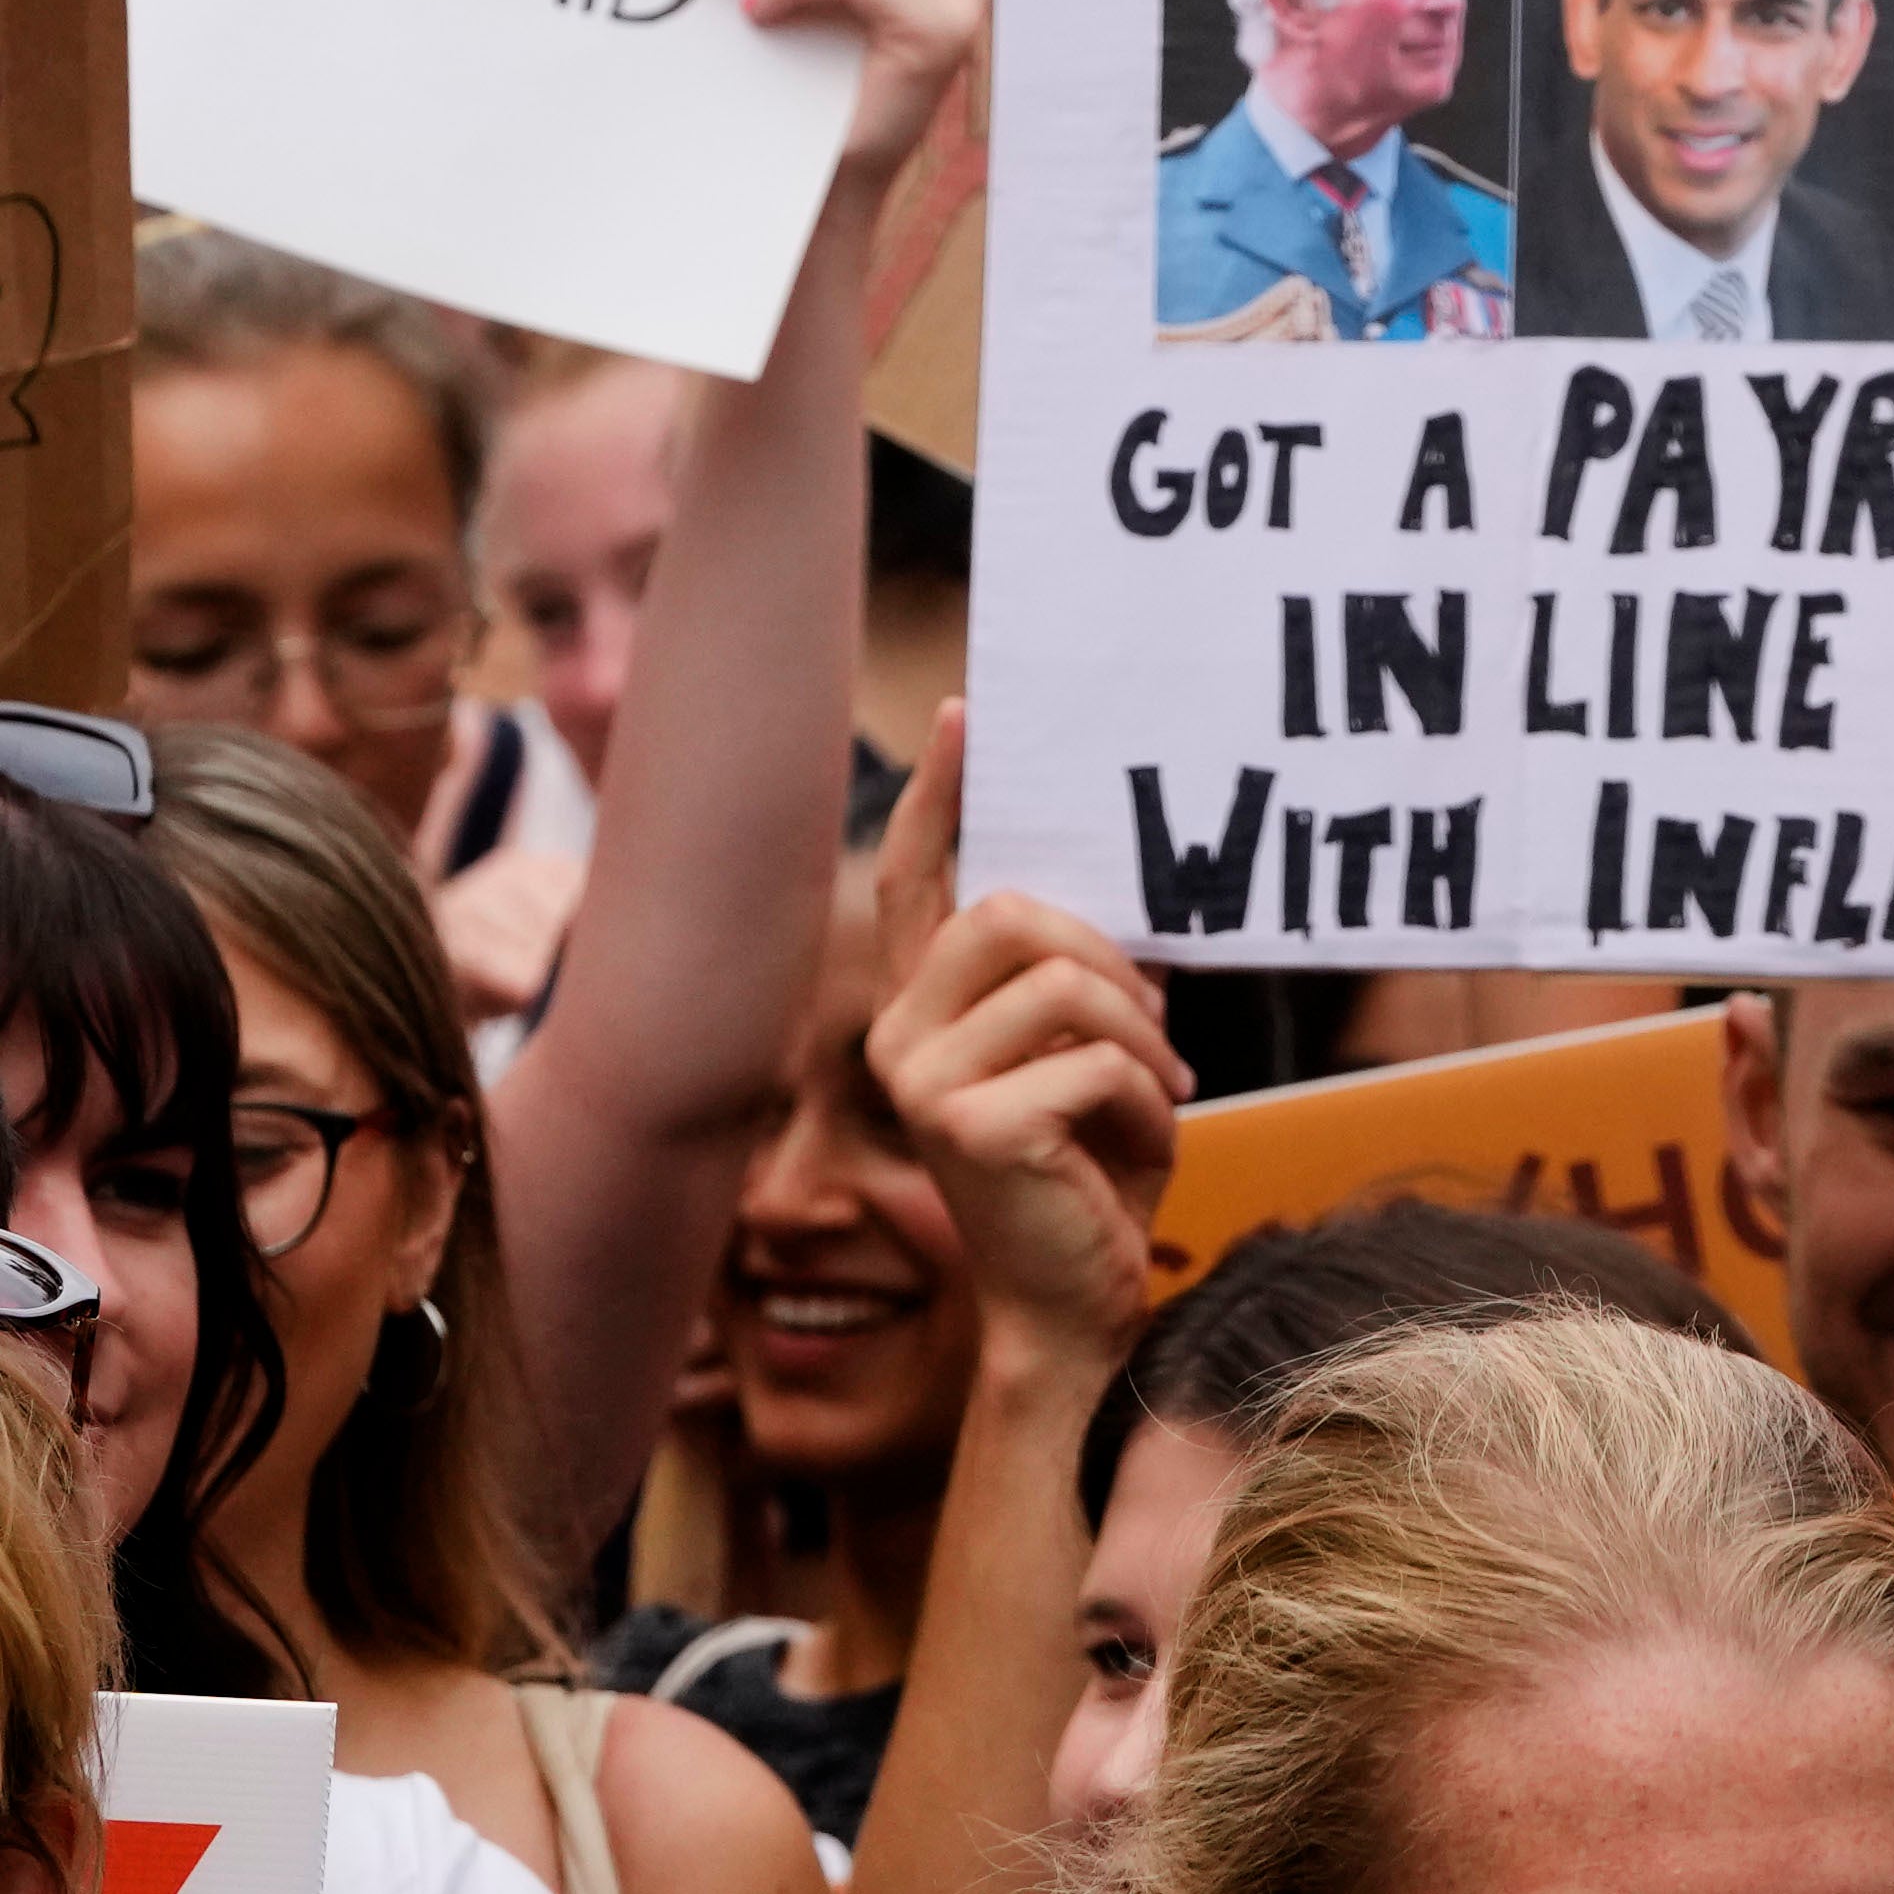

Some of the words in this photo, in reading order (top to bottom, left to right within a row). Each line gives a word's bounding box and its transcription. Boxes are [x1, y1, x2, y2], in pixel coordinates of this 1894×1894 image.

[1110, 409, 1325, 539] GOT
[1400, 412, 1477, 534] A
[1279, 591, 1467, 740] IN
[1524, 591, 1848, 752] LINE
[1126, 764, 1485, 940] WITH
